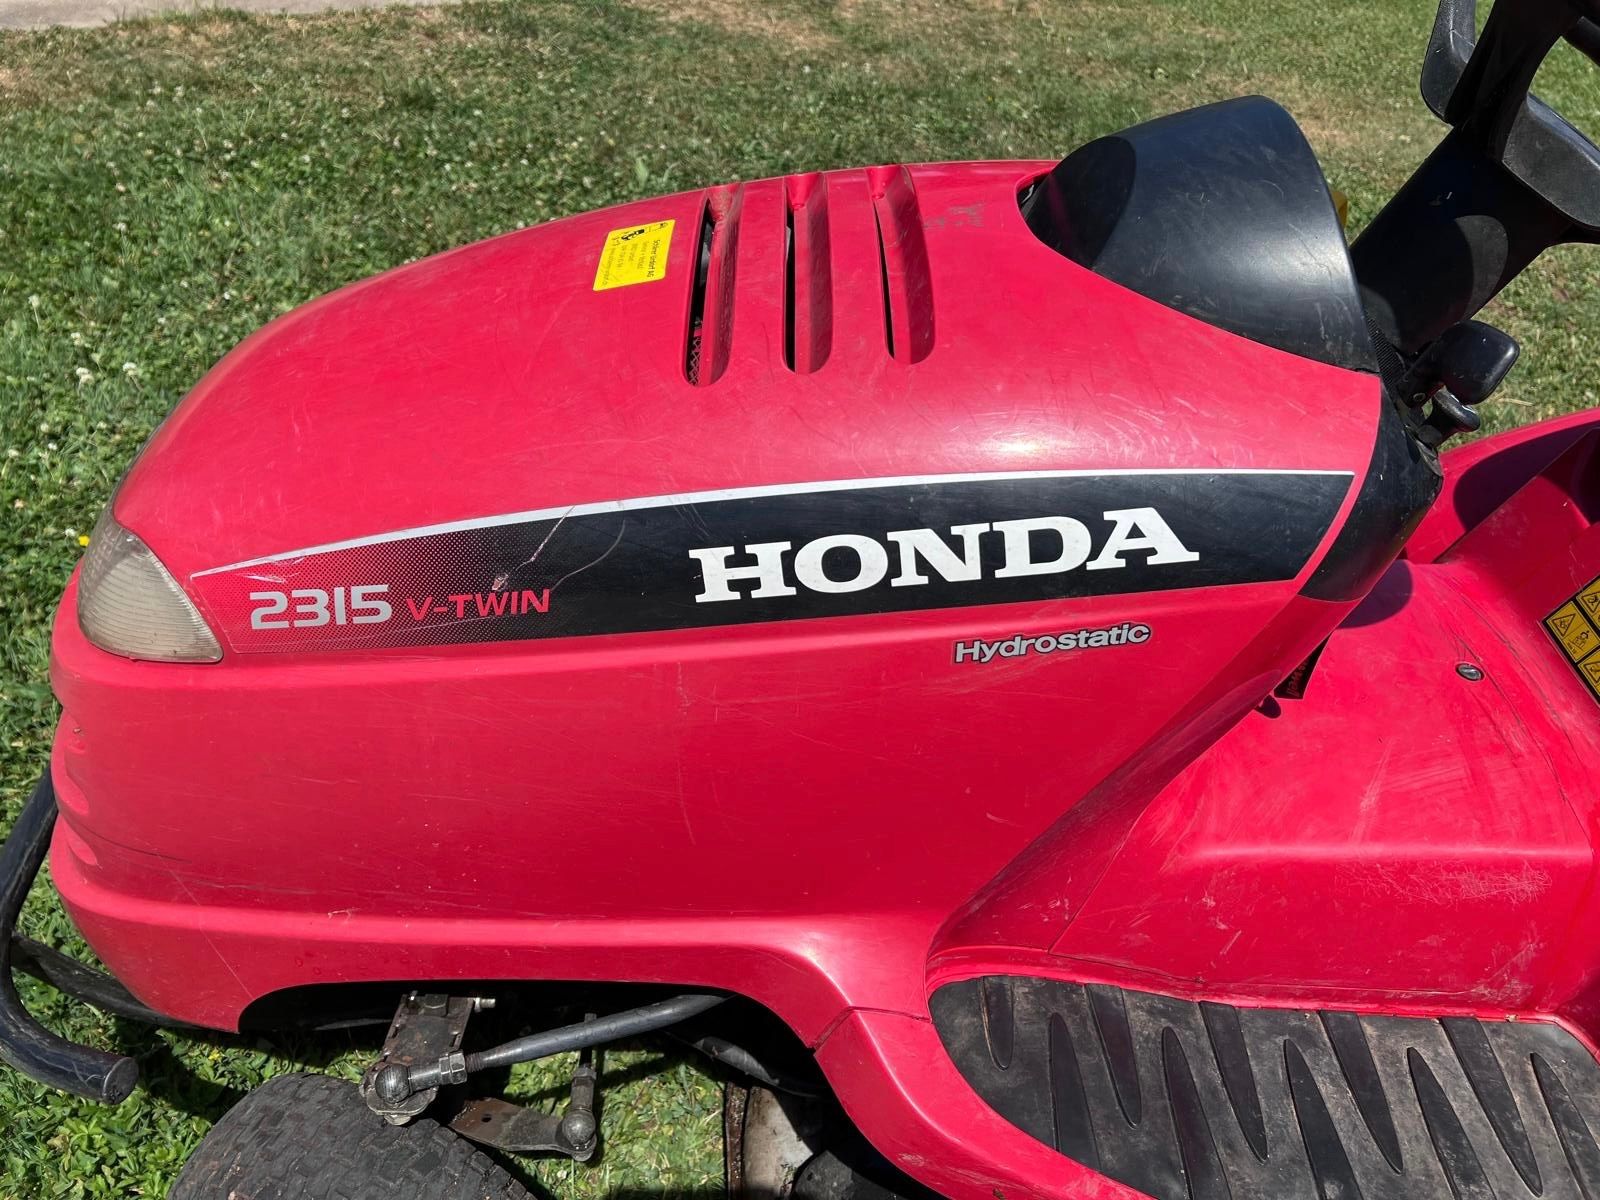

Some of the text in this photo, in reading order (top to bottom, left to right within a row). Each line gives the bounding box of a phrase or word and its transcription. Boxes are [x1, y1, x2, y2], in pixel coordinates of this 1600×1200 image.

[688, 507, 1200, 603] HONDA
[249, 584, 551, 630] 2315 V-TWIN
[954, 623, 1151, 664] Hydrostatic
